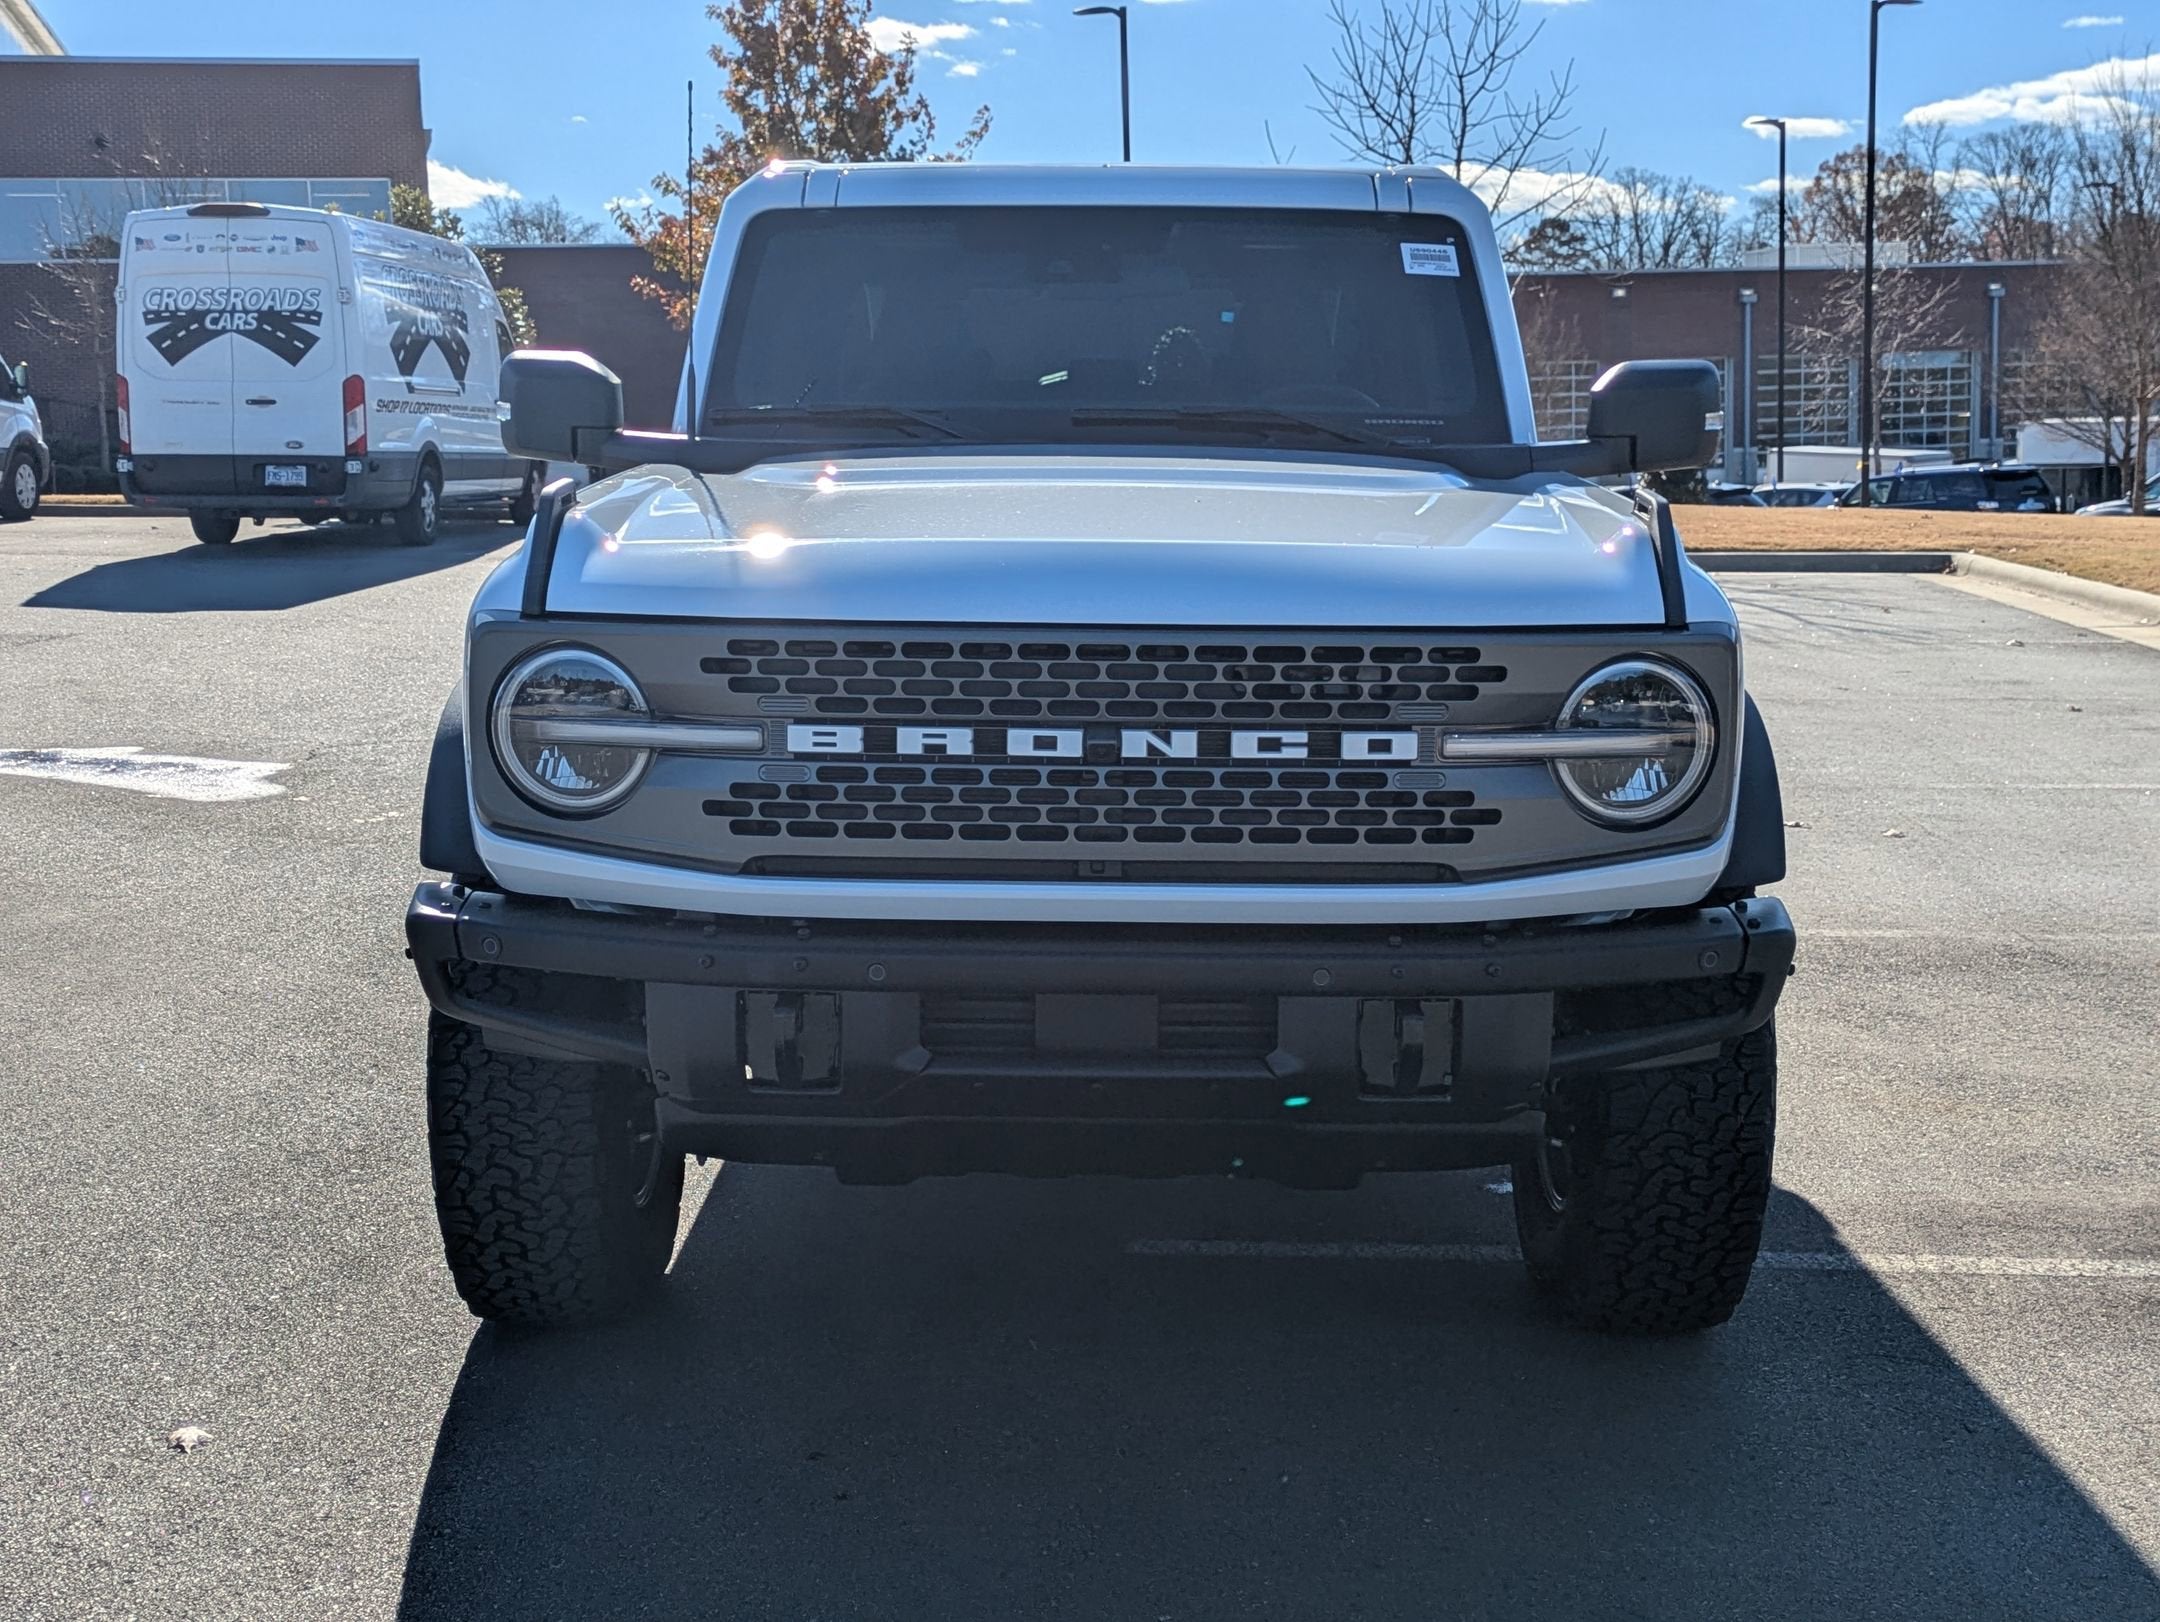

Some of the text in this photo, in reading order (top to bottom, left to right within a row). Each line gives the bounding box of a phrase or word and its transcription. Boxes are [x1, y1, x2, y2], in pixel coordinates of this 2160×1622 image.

[143, 288, 321, 312] CROSSROADS
[382, 266, 465, 310] CROSSROADS
[205, 312, 259, 331] CARS
[417, 312, 444, 337] CARS
[376, 399, 400, 413] SHOP
[409, 401, 452, 415] LOCATIONS
[787, 727, 1420, 760] BRONCO
